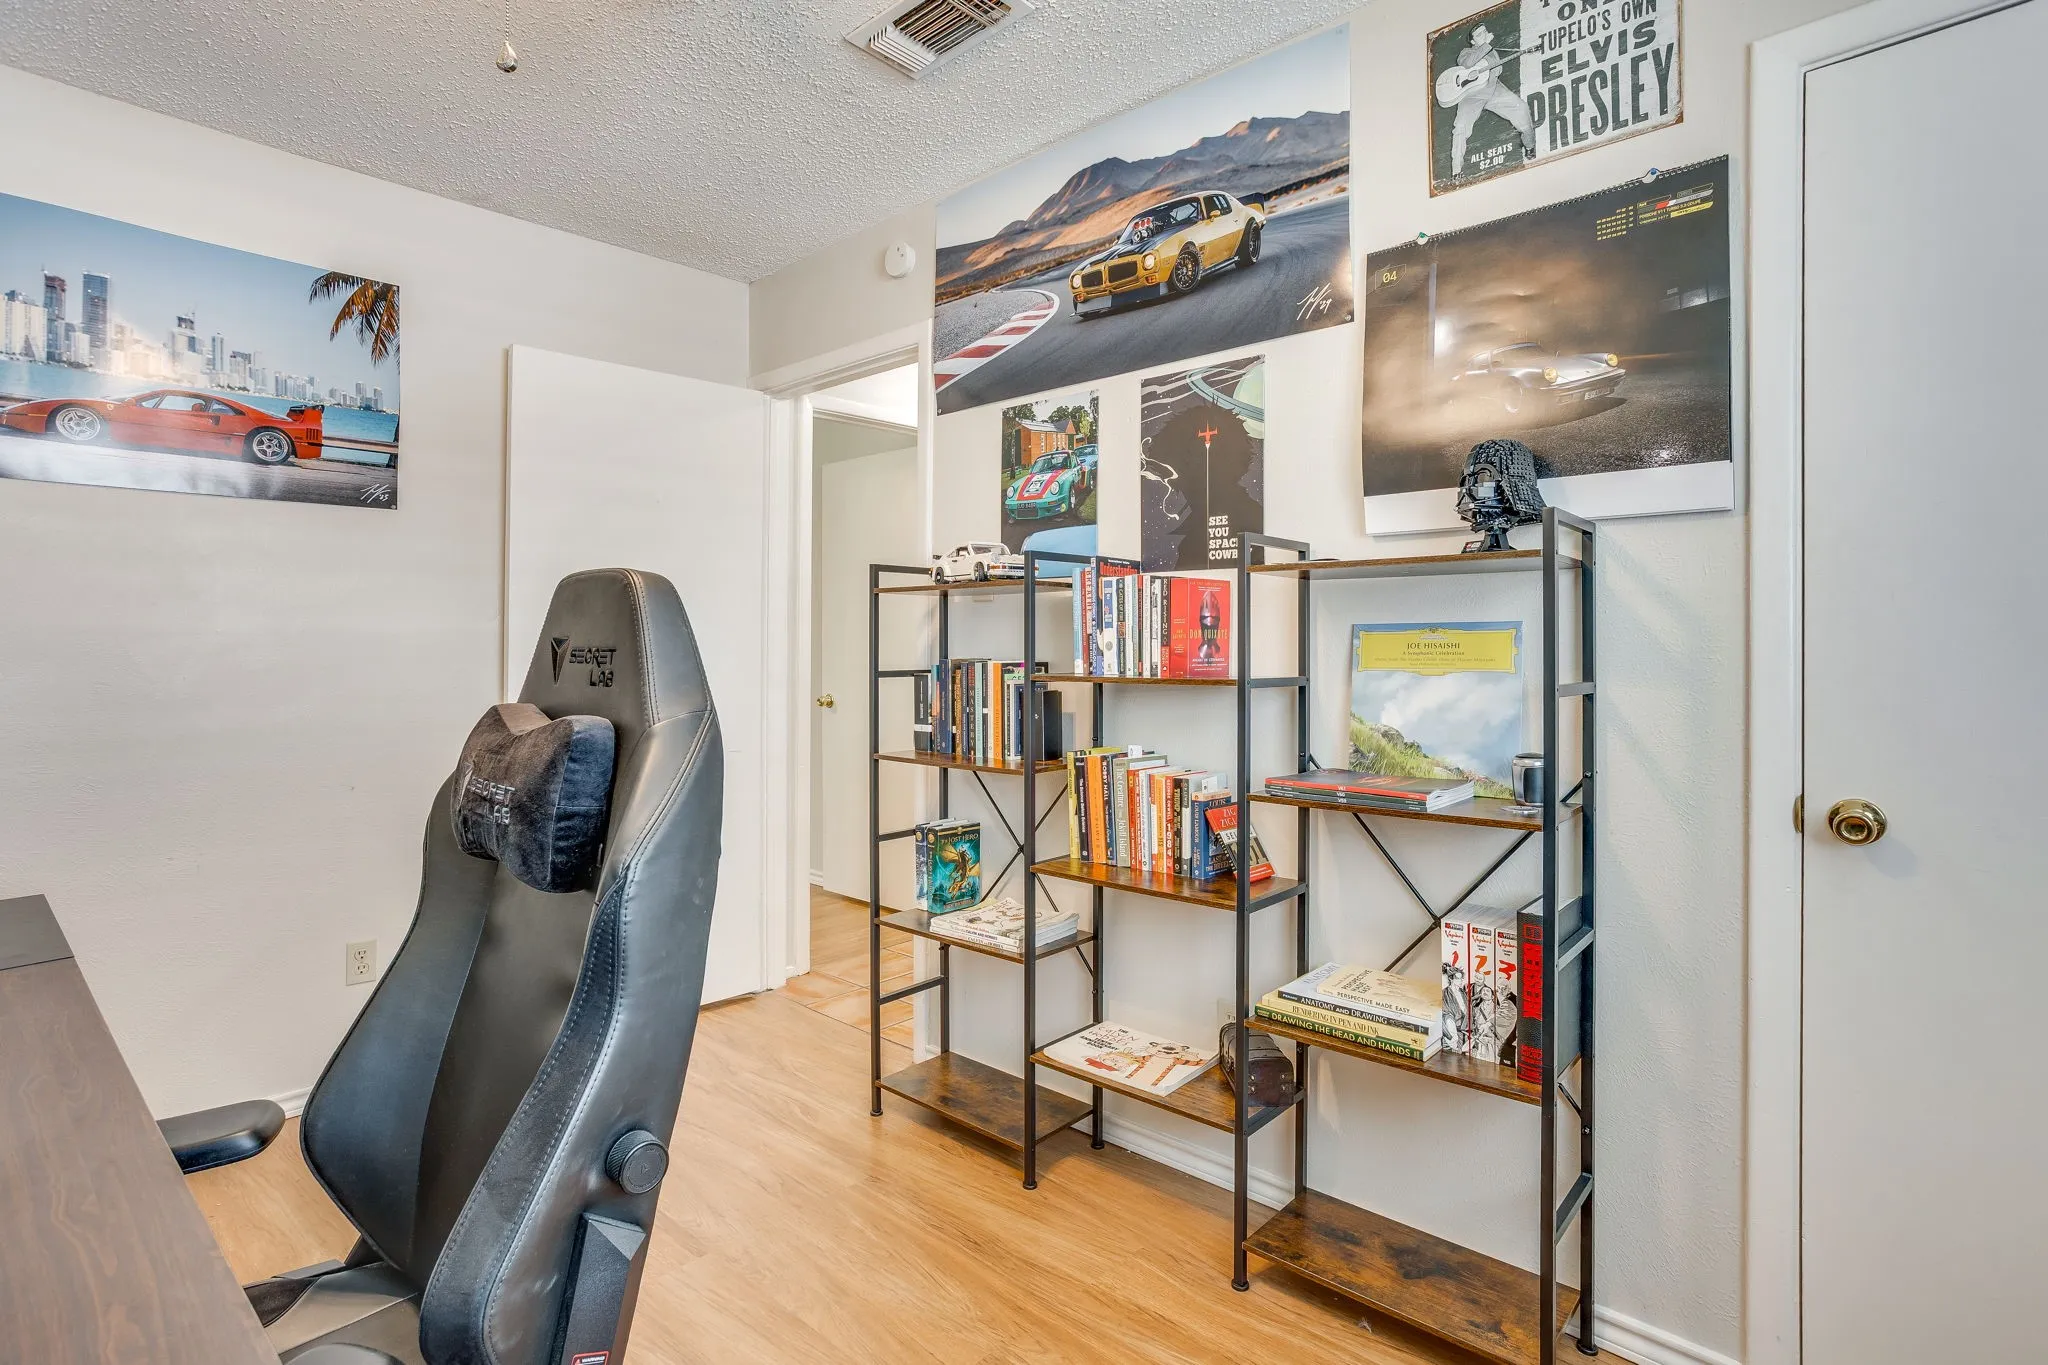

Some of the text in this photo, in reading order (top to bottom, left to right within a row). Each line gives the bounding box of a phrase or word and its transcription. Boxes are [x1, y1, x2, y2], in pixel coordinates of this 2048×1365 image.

[1538, 0, 1657, 54] TUPELO'S OWN
[1541, 19, 1658, 84] ELVIS
[1527, 42, 1675, 152] PRESLEY
[1470, 142, 1513, 164] ALL SEATS
[1479, 155, 1504, 170] $2.00
[1382, 270, 1397, 283] 04
[1208, 515, 1229, 526] SEE
[1208, 526, 1229, 538] YOU
[1208, 537, 1238, 549] SPAC
[1208, 549, 1238, 561] COWB
[1189, 628, 1202, 639] DON
[1204, 629, 1228, 641] QUIXOTE
[1407, 642, 1460, 650] JOE HISAISHI
[569, 647, 617, 666] SECRET
[589, 670, 614, 688] LAB
[1116, 768, 1124, 779] The
[466, 776, 516, 806] SECRET
[1117, 780, 1126, 808] Creature
[1209, 798, 1226, 807] LOUIS
[485, 804, 511, 825] LAB
[1223, 807, 1237, 817] ZIG
[1118, 819, 1127, 837] Jekyll
[1220, 817, 1237, 828] ZIGL
[949, 836, 962, 844] LOST
[962, 833, 979, 841] HERO
[1118, 838, 1127, 857] Island
[1497, 939, 1517, 949] Vagabon
[1474, 954, 1491, 976] 2
[1498, 959, 1516, 981] 3
[1300, 997, 1388, 1025] ANATOMY AND DRAWING
[1336, 991, 1410, 1014] PERSPECTIVE MADE EASY
[1292, 1005, 1329, 1022] RENDERING
[1329, 1015, 1338, 1024] IN
[1338, 1017, 1352, 1027] PEN
[1352, 1020, 1367, 1030] AND
[1367, 1025, 1380, 1036] INK
[1271, 1012, 1313, 1030] DRAWING
[1314, 1023, 1331, 1036] THE
[1332, 1028, 1356, 1043] HEAD
[1356, 1036, 1377, 1048] AND
[1378, 1041, 1411, 1057] HANDS
